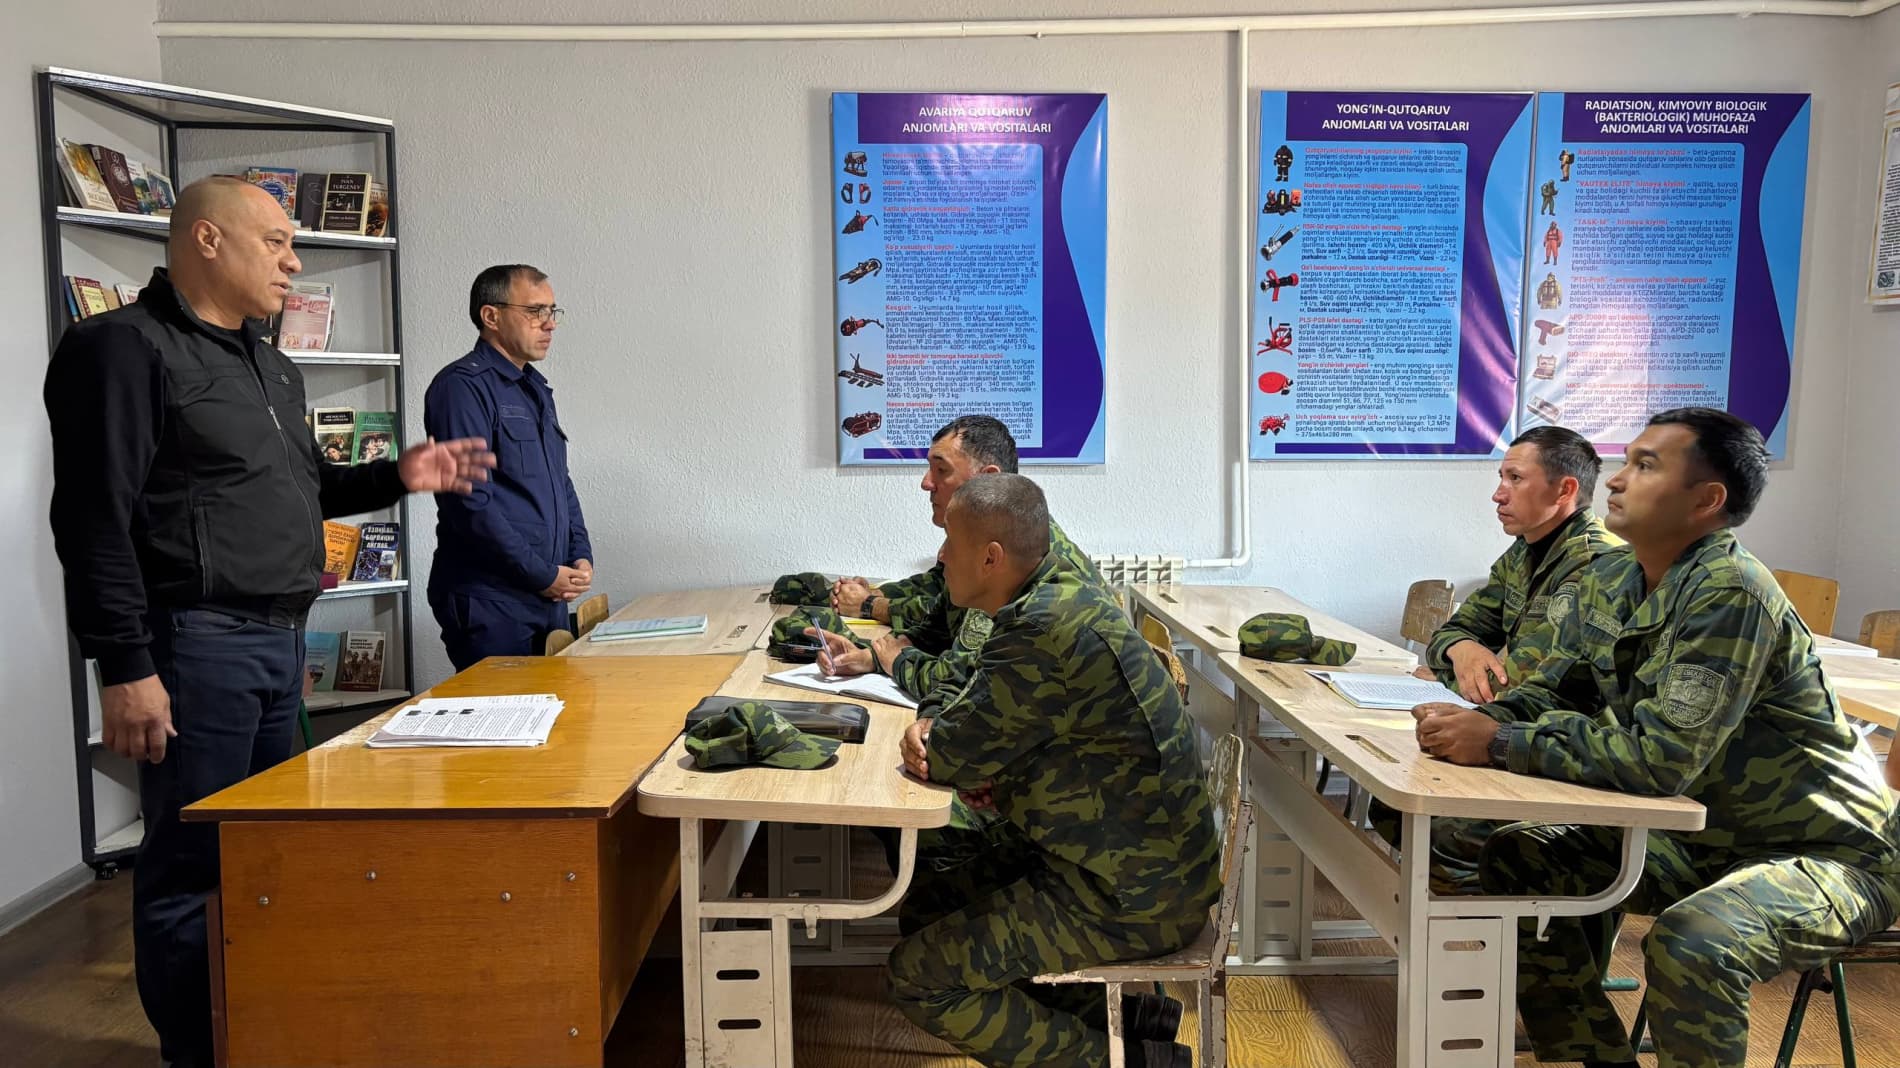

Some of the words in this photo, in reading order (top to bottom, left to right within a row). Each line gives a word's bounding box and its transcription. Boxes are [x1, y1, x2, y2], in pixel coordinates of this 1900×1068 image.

[1585, 100, 1655, 112] RADIATSION,
[1658, 100, 1712, 111] KIMYOVIY
[1715, 100, 1767, 111] BIOLOGIK
[919, 106, 966, 117] AVARIYA
[969, 106, 1032, 118] QUTQARUV
[1594, 112, 1690, 124] (BAKTERIOLOGIK)
[1693, 112, 1756, 123] MUHOFAZA
[902, 122, 968, 133] ANJOMLARI
[970, 122, 985, 133] VA
[988, 122, 1051, 133] VOSITALARI
[1322, 120, 1387, 130] ANJOMLARI
[1389, 120, 1404, 130] VA
[1407, 120, 1469, 131] VOSITALARI
[1600, 123, 1666, 134] ANJOMLARI
[1668, 123, 1684, 134] VA
[1686, 123, 1749, 134] VOSITALARI
